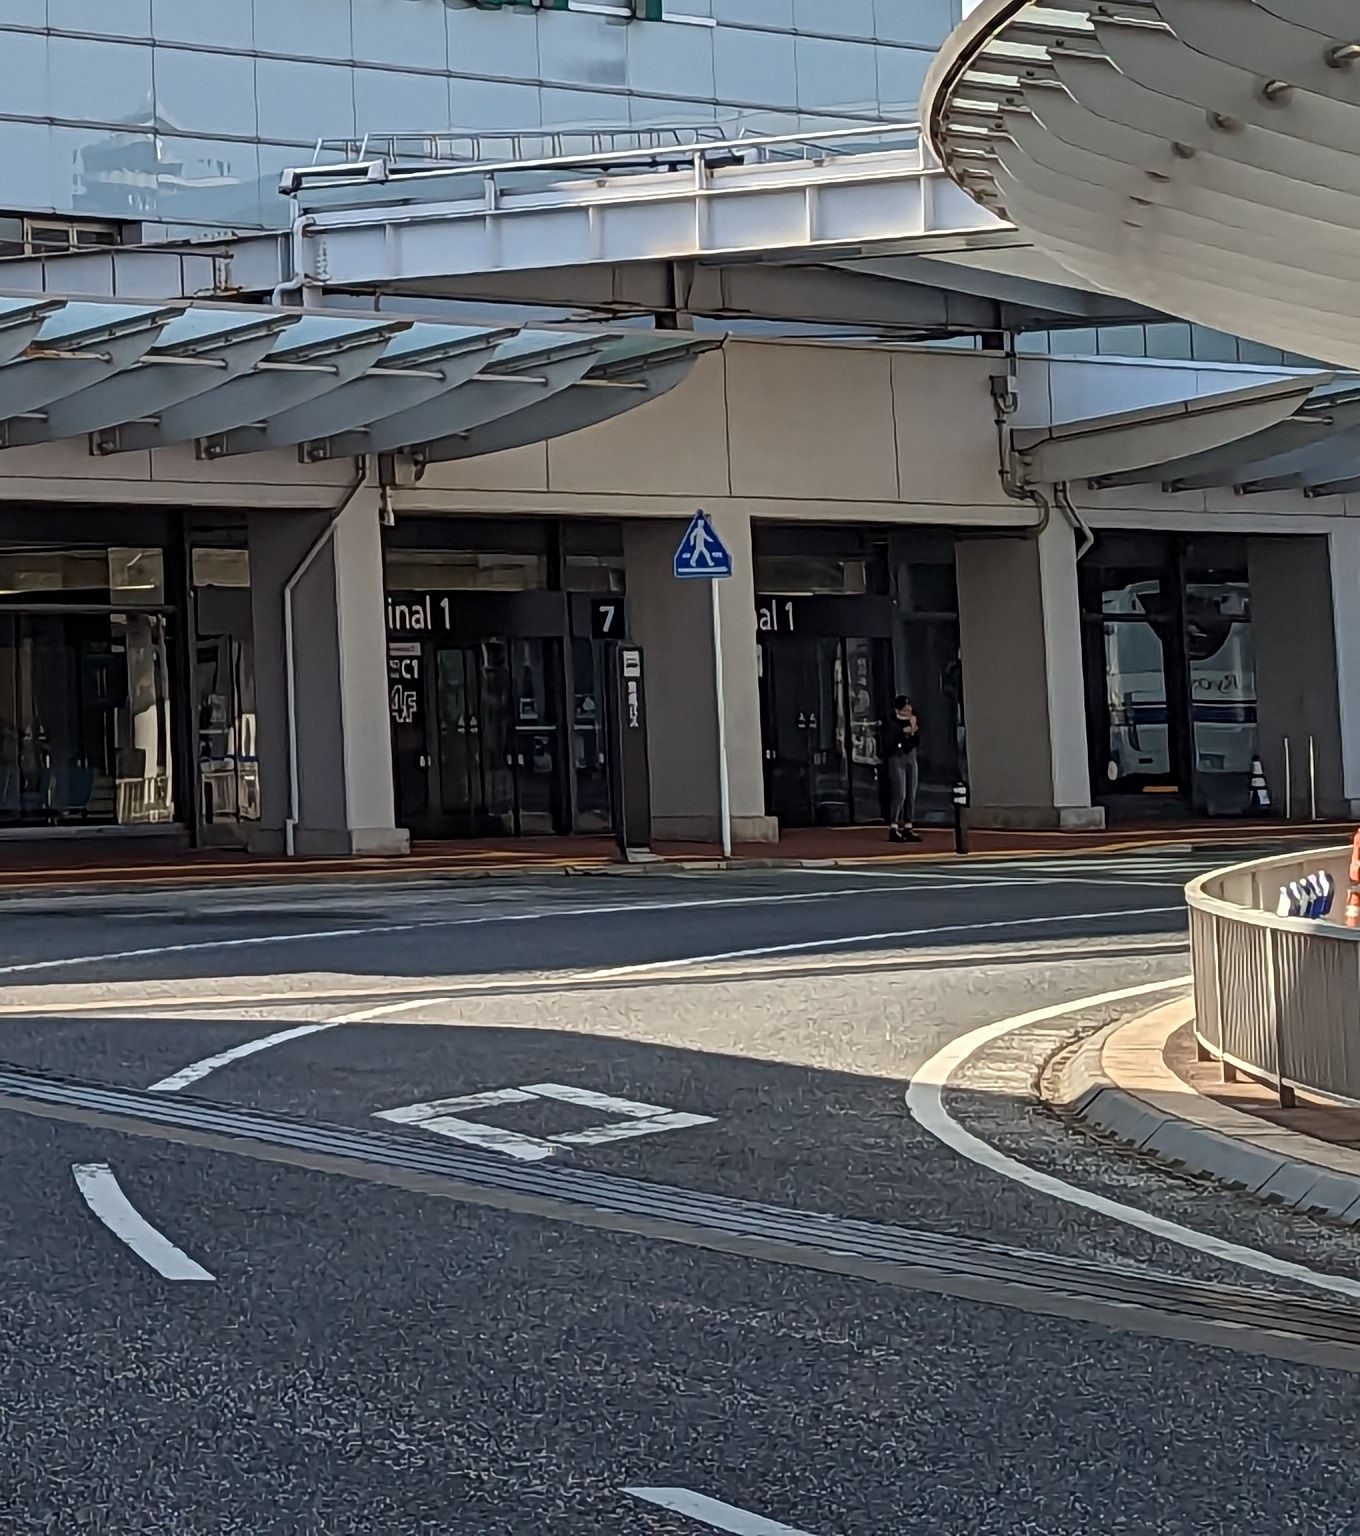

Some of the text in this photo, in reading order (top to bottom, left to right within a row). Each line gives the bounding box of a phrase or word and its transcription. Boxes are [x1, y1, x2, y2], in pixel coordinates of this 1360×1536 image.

[388, 595, 451, 630] inal 1
[599, 606, 615, 633] 7
[759, 599, 794, 631] al 1
[401, 659, 419, 679] C1
